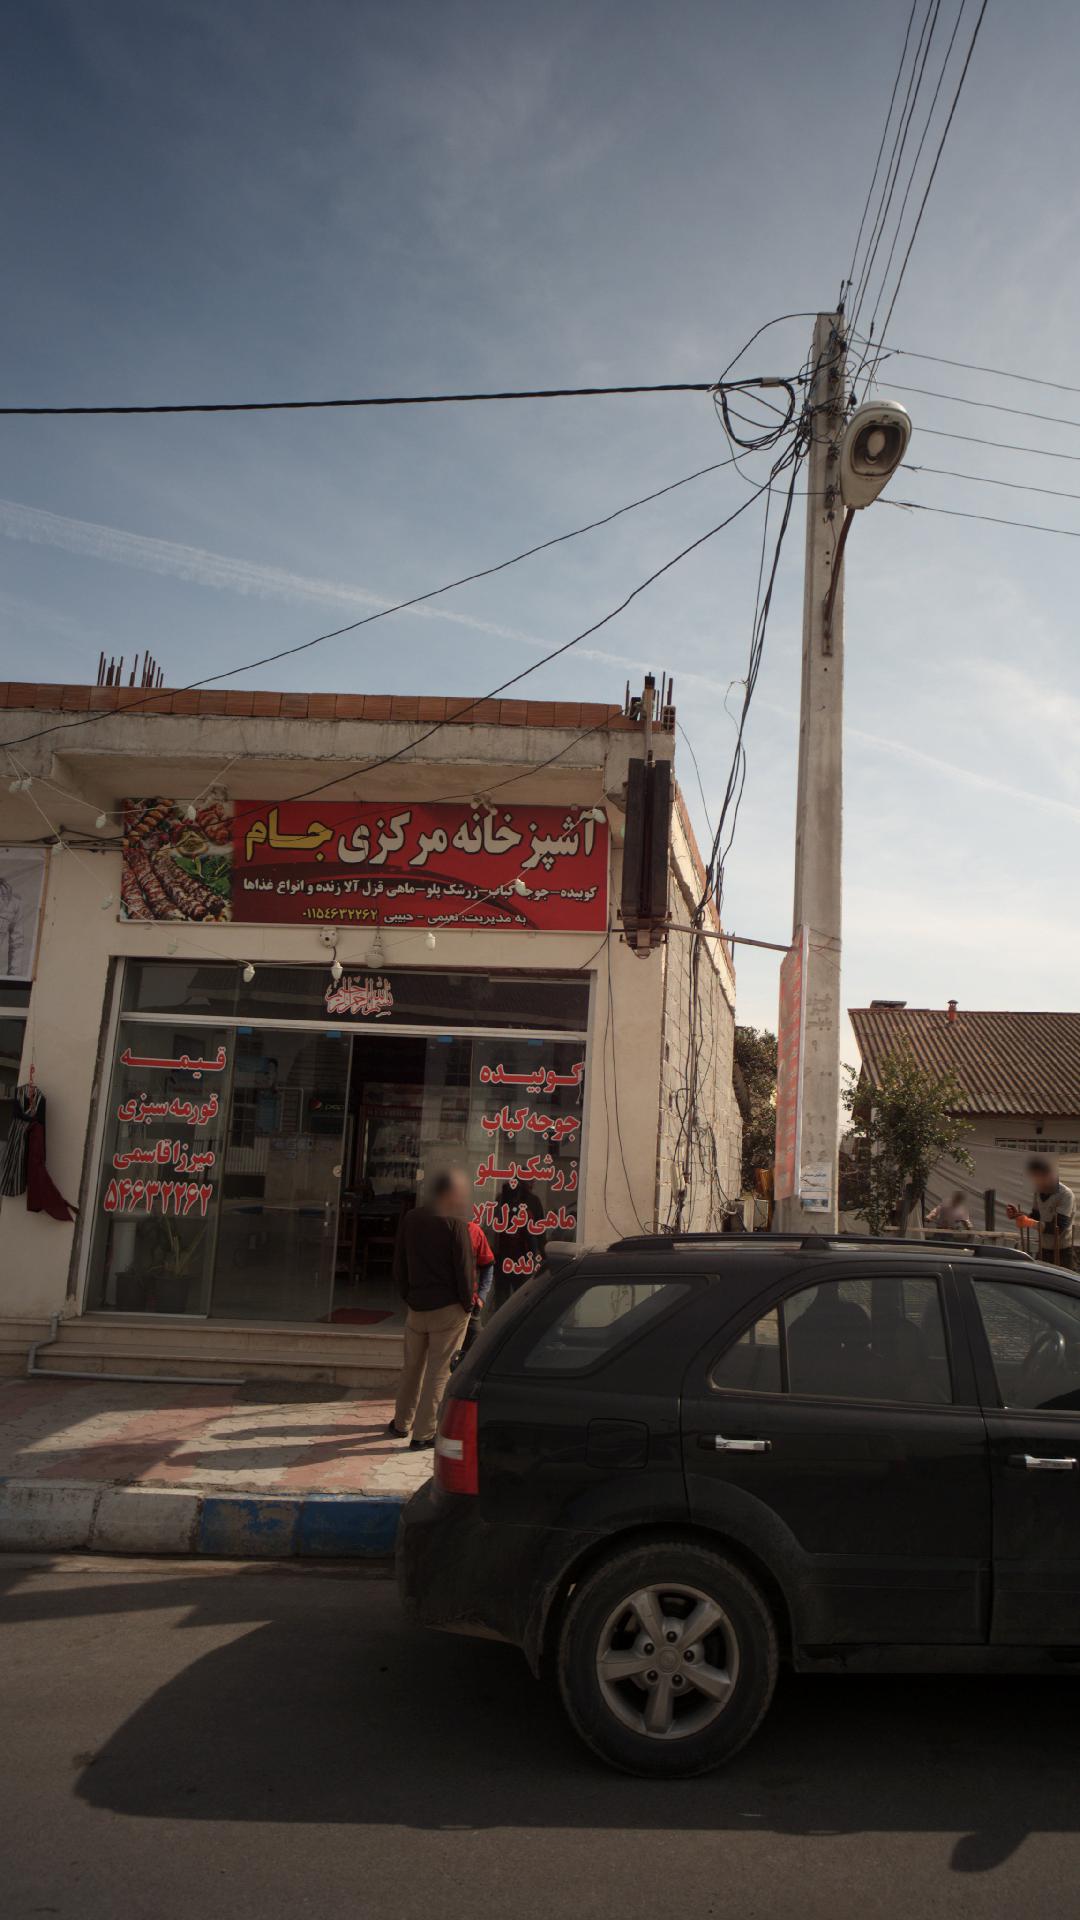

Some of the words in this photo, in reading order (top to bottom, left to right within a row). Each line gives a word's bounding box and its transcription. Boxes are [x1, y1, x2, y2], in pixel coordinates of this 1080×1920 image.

[244, 806, 334, 862] جام
[337, 810, 448, 867] مرکزی
[243, 878, 274, 891] غذاها
[276, 879, 305, 894] انواع
[307, 882, 314, 895] و
[316, 880, 341, 895] زنده
[362, 880, 384, 896] قزل
[386, 881, 416, 897] ماهی
[426, 883, 441, 899] پلو
[443, 884, 479, 899] زرشک
[488, 884, 517, 898] کباب
[516, 887, 550, 901] جوج
[560, 886, 598, 901] کوبیده
[515, 915, 527, 925] به
[120, 1046, 227, 1079] قیمه
[480, 1062, 585, 1093] کوبیده
[117, 1093, 169, 1124] سبزی
[168, 1093, 219, 1125] قورمه
[481, 1105, 529, 1139] کباب
[526, 1111, 580, 1142] جوجه
[473, 1152, 518, 1190] پلو
[516, 1153, 578, 1191] زرشک
[103, 1178, 213, 1217] ۵۴۶۳۲۲۶۲
[492, 1203, 528, 1234] قزل
[527, 1206, 576, 1236] ماهی
